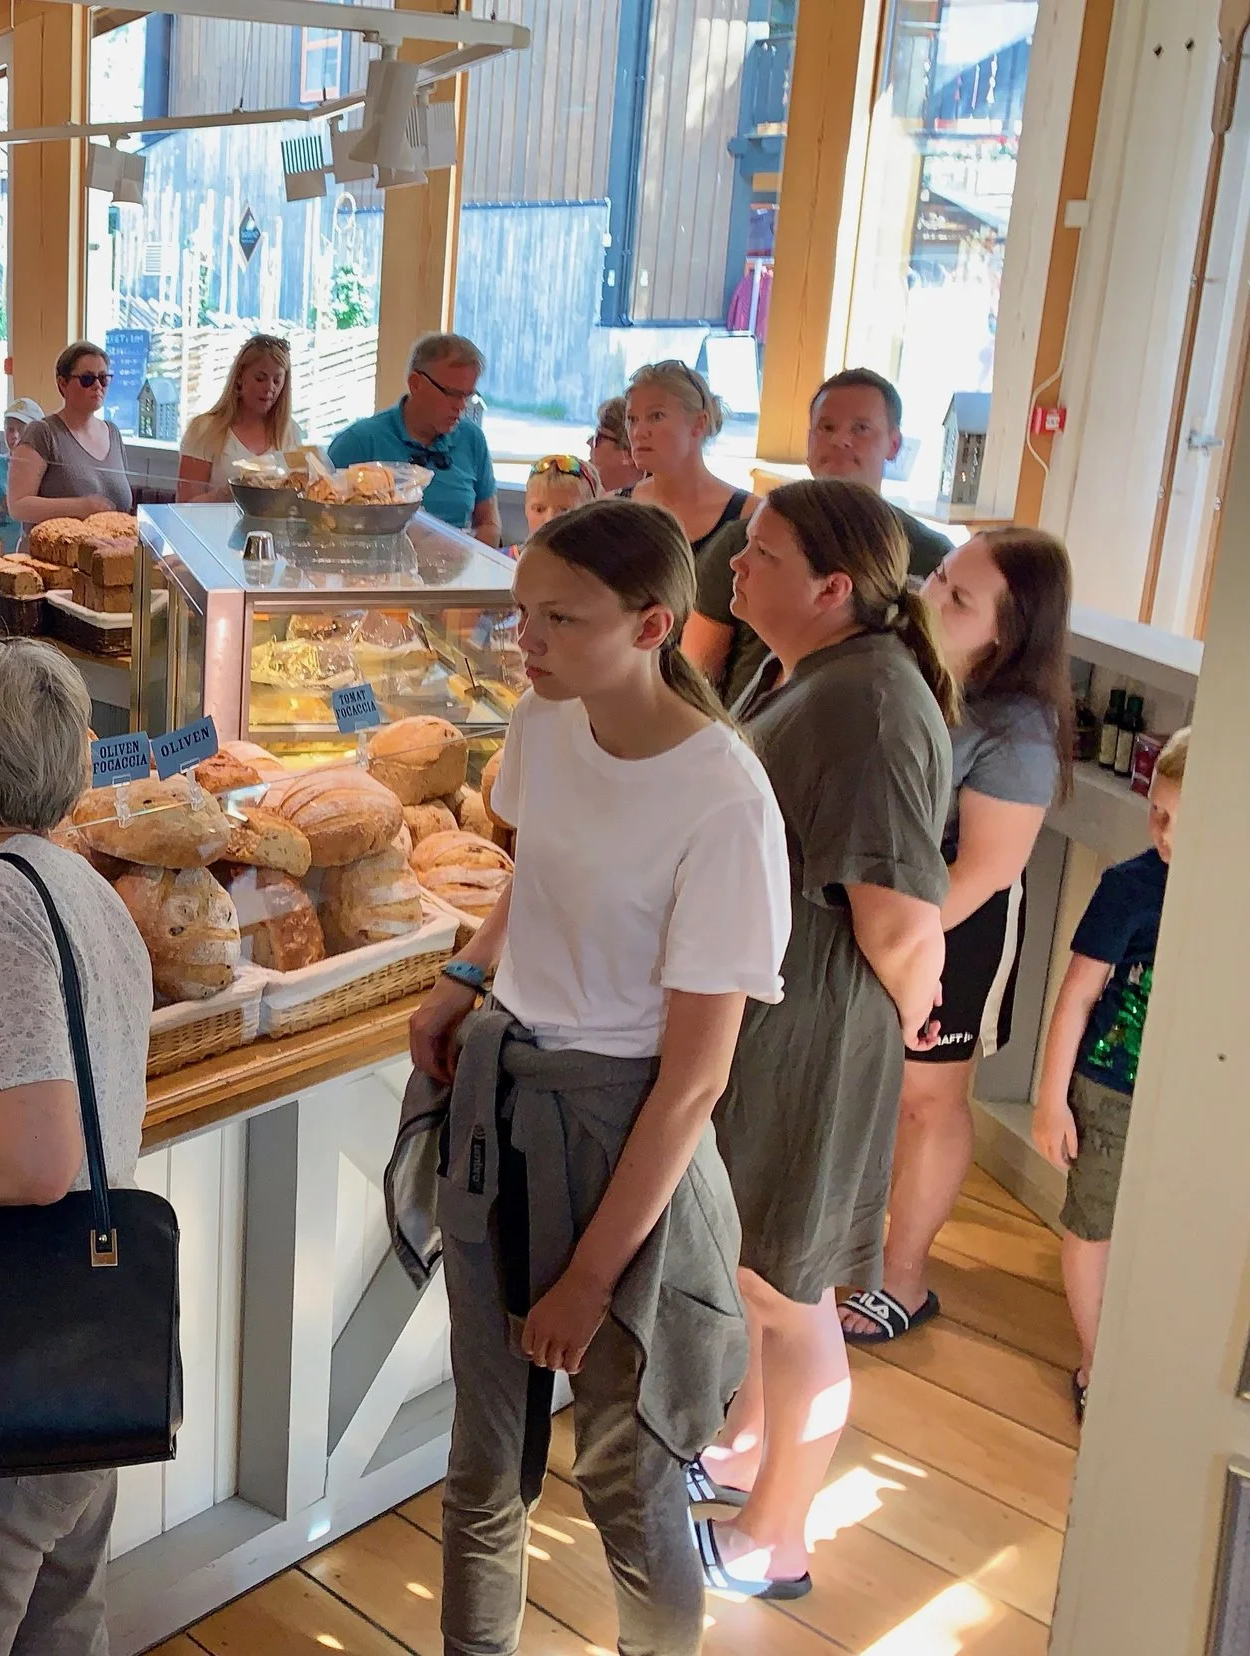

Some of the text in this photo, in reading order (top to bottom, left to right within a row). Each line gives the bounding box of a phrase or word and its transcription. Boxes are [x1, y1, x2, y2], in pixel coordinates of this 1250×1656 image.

[339, 690, 366, 706] TOMAT
[335, 700, 377, 720] FOCACCIA
[99, 740, 140, 759] OLIVEN
[160, 726, 211, 758] OLIVEN
[92, 753, 148, 775] FOCACCIA
[937, 1032, 964, 1047] AFT
